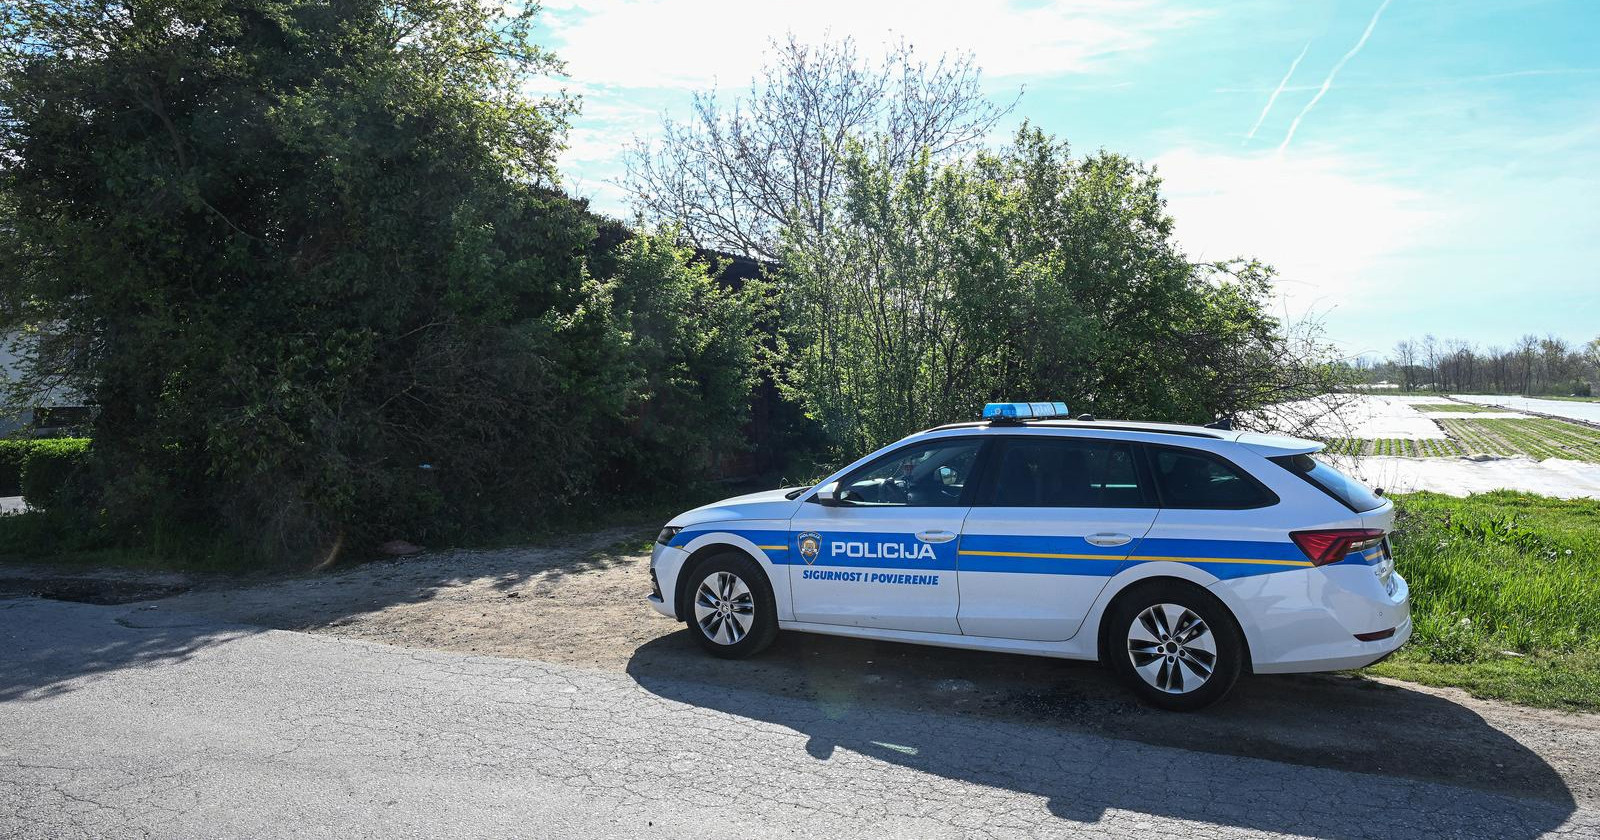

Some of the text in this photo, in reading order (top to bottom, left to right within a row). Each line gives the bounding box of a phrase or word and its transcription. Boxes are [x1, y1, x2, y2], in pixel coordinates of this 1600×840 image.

[831, 541, 937, 560] POLICIJA
[803, 570, 939, 585] SIGURNOST I POVJERENJE
